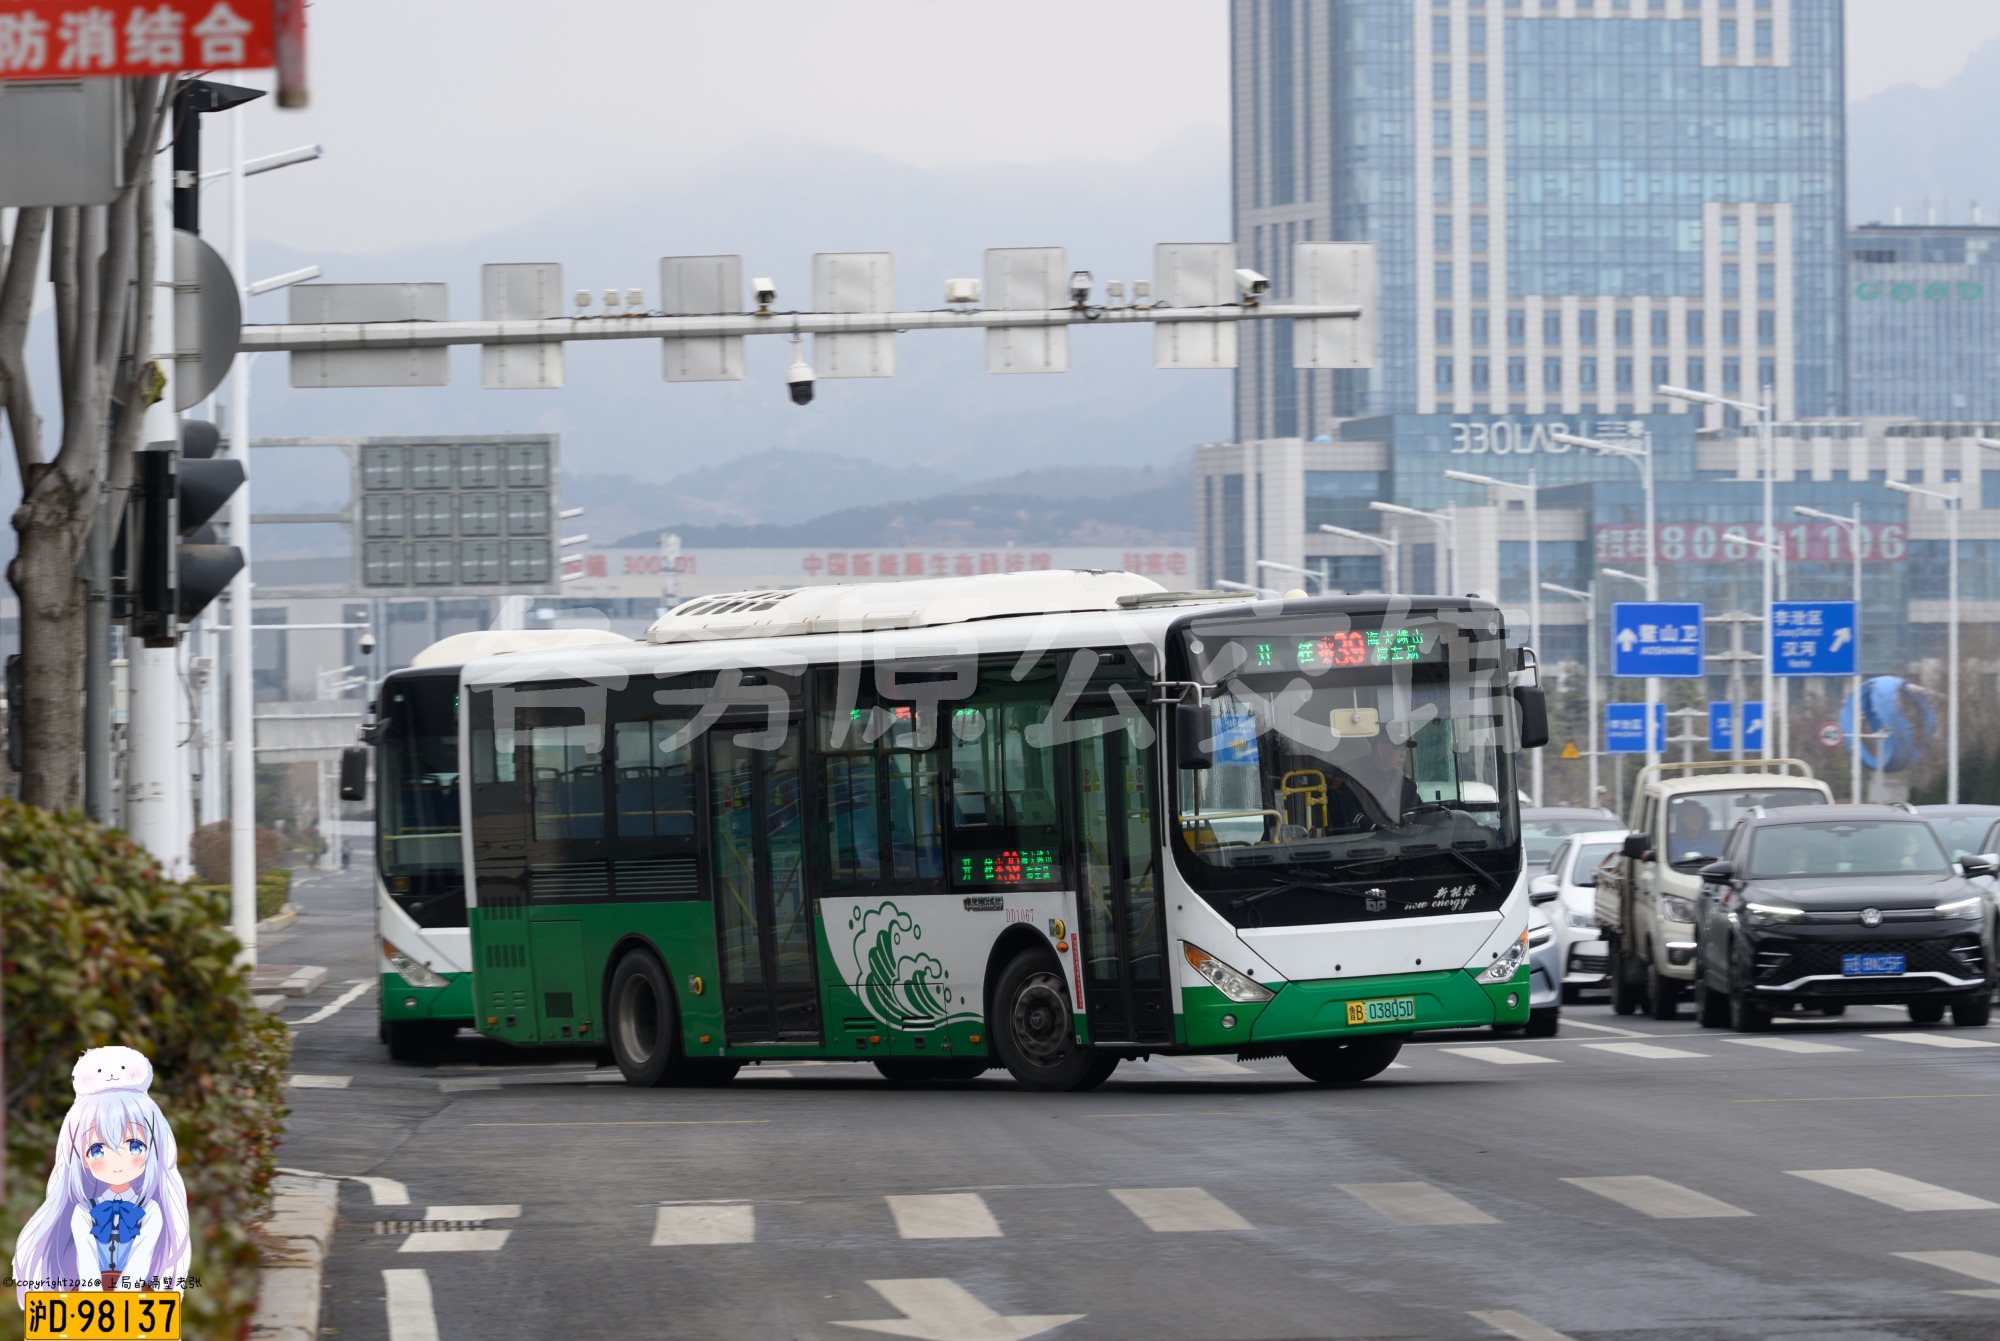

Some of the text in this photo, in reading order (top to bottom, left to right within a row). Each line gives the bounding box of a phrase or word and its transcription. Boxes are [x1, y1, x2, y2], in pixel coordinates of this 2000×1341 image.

[0, 3, 253, 72] 防消结合
[1433, 884, 1477, 899] 新能源
[1431, 897, 1470, 911] energy
